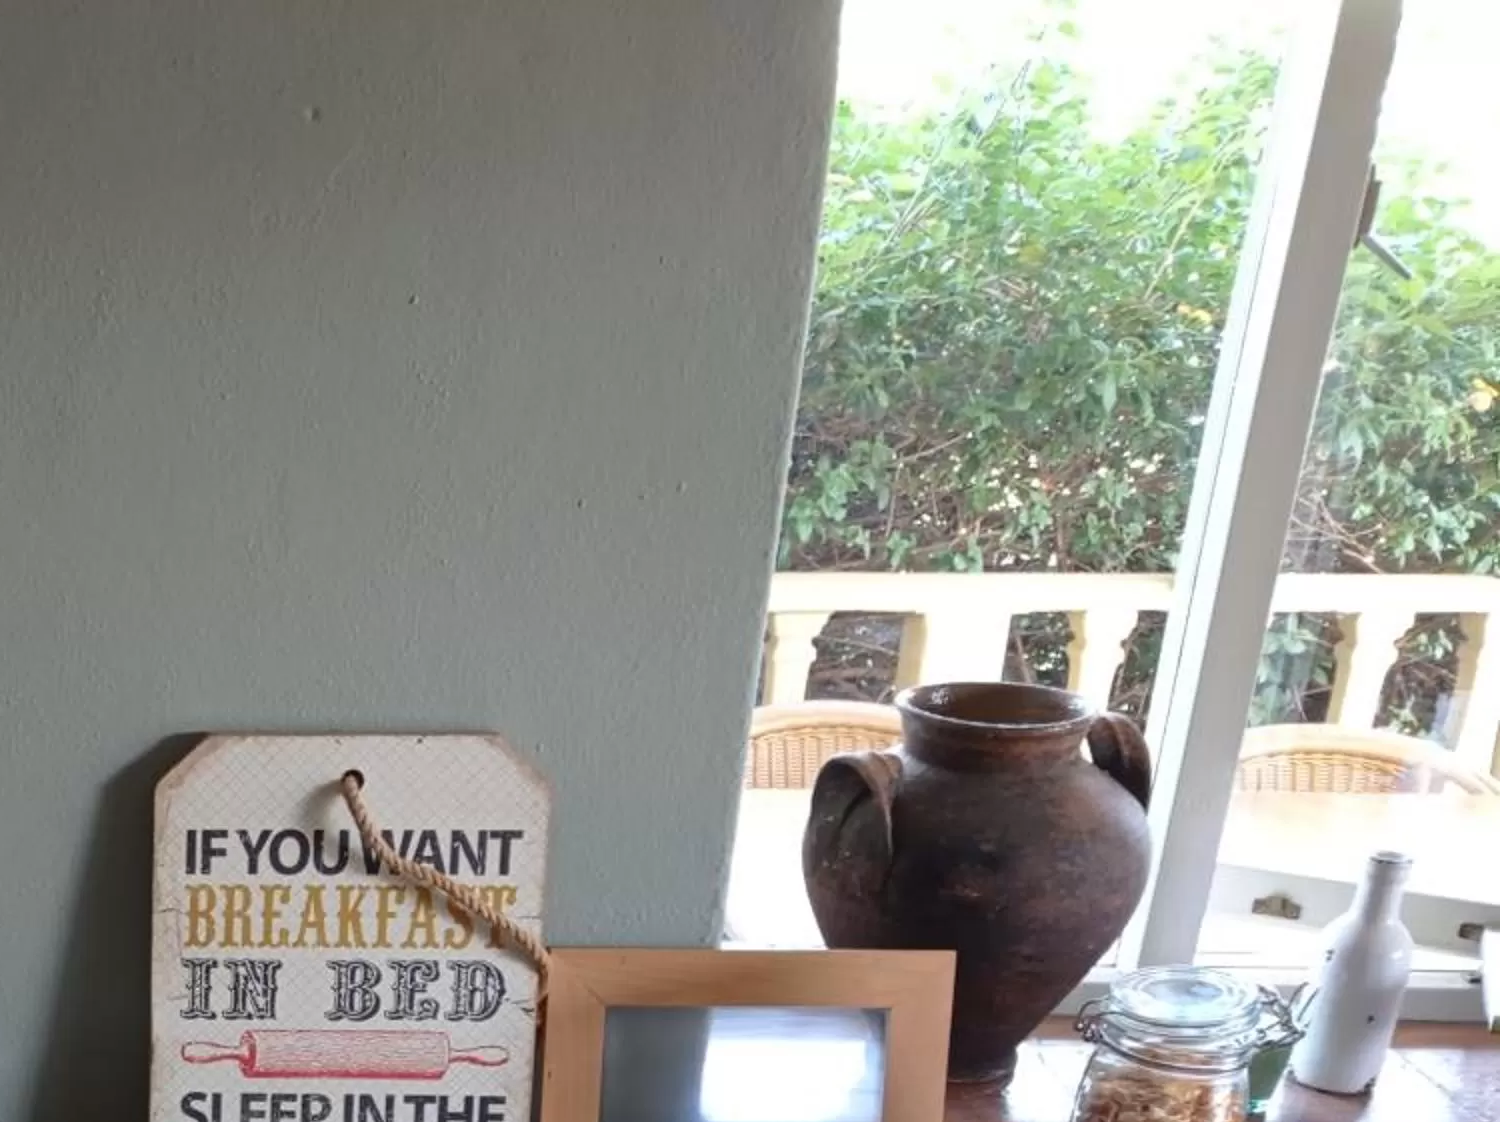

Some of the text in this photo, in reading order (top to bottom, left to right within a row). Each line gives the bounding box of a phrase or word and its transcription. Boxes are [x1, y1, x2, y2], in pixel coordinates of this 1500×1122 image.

[185, 829, 524, 876] IF YOU WANT
[184, 883, 518, 950] BREAKFAST
[180, 957, 508, 1022] IN BED
